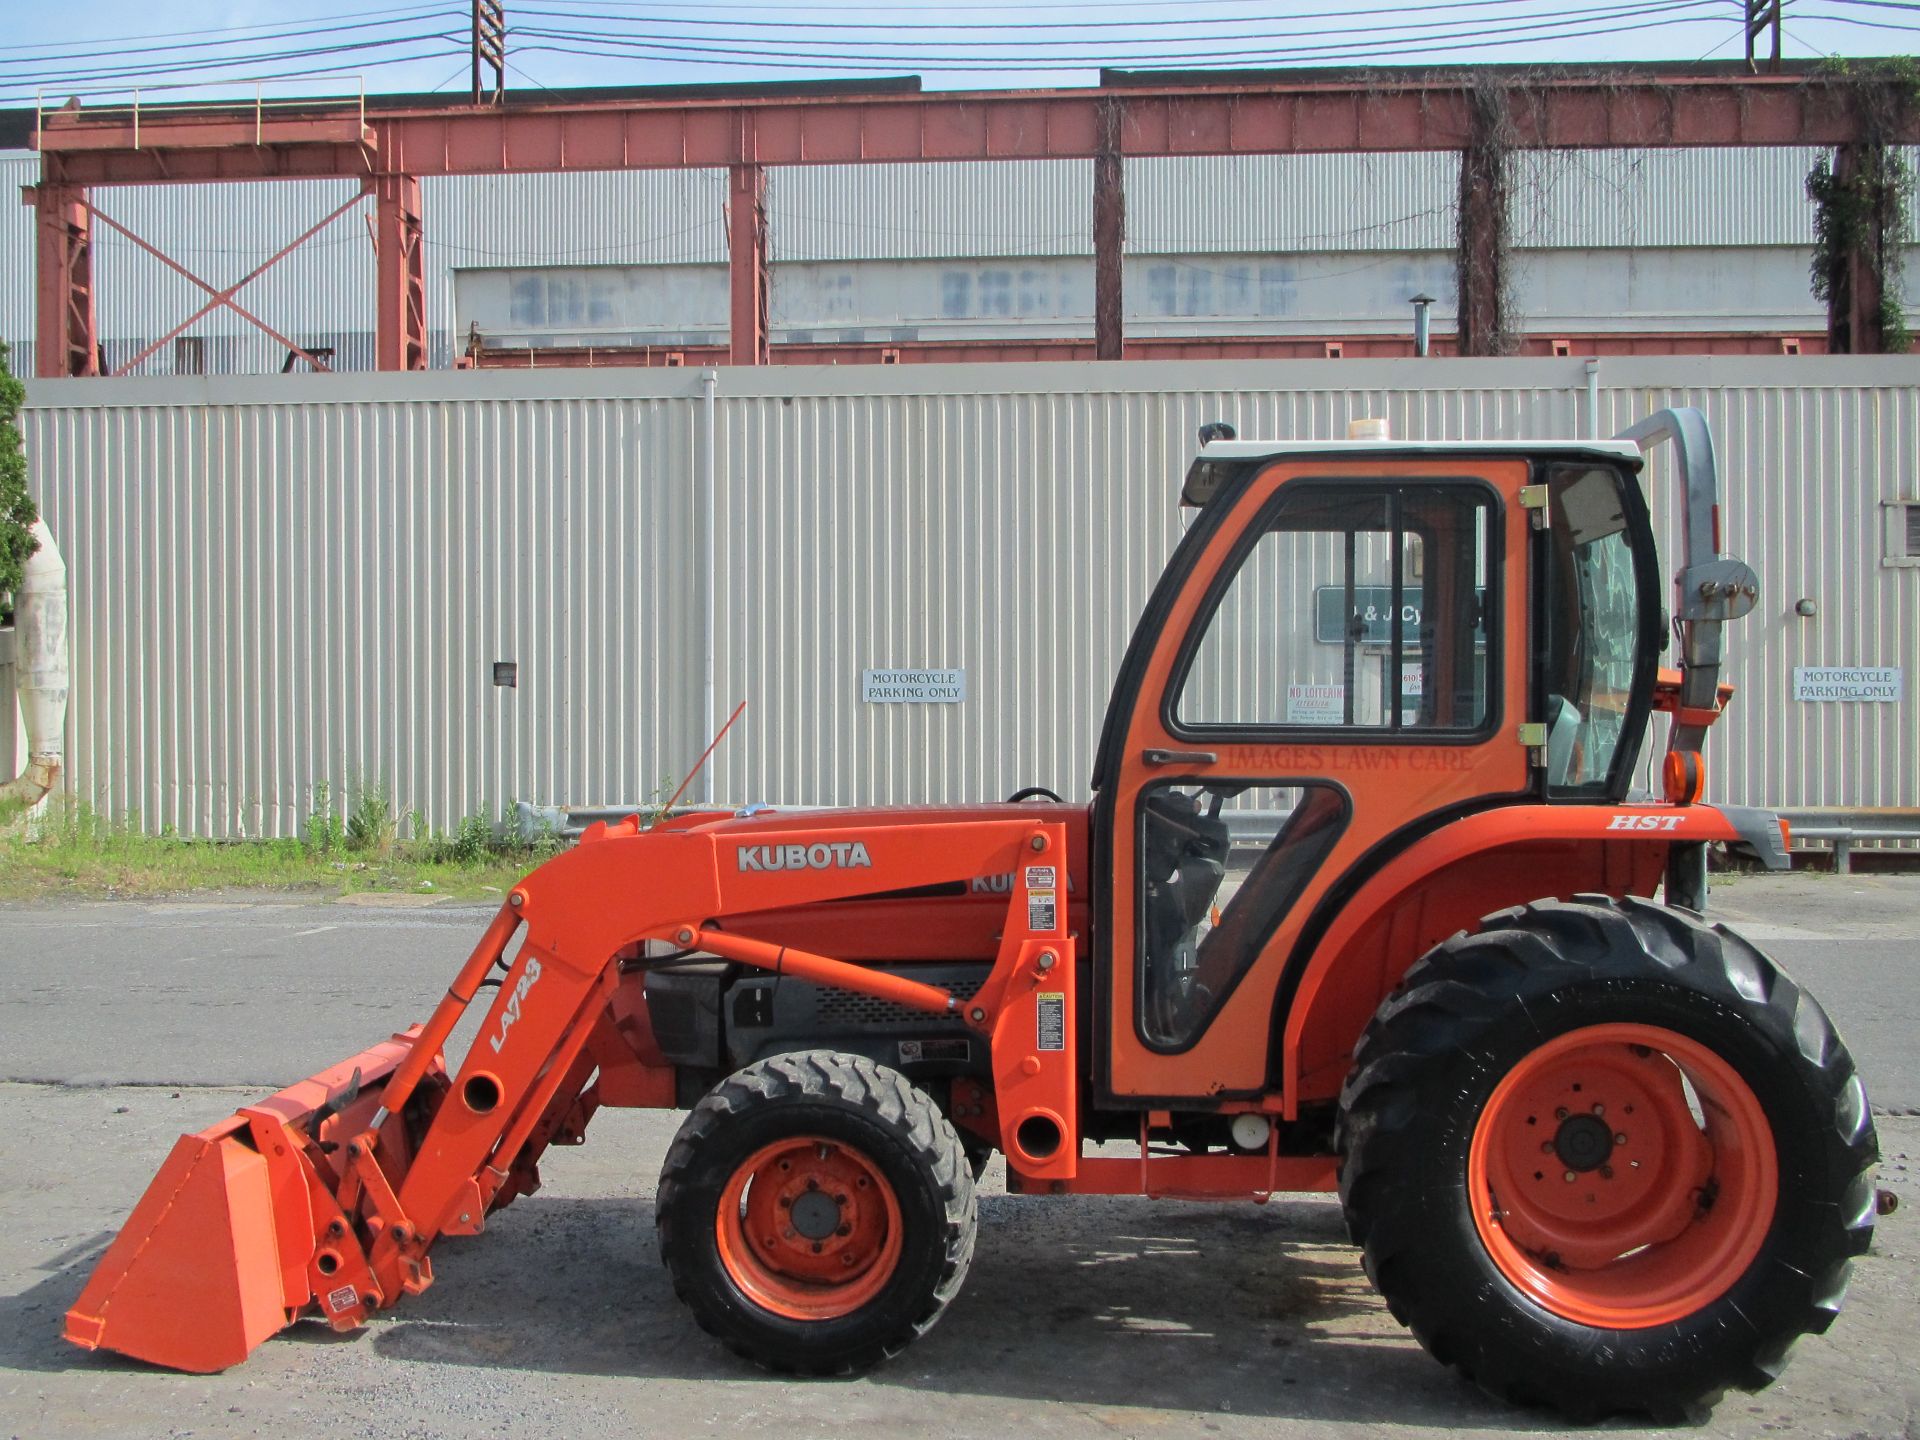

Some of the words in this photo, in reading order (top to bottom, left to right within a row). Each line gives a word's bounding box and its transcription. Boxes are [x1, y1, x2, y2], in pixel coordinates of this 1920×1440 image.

[1364, 605, 1378, 621] &
[872, 673, 956, 684] MOTORCYCLE
[1803, 671, 1892, 683] MOTORCYCLE
[868, 687, 924, 698] PARKING
[928, 687, 961, 698] ONLY
[1289, 687, 1301, 698] NO
[1304, 687, 1345, 699] LOITERIN
[1800, 686, 1858, 698] PARKING
[1863, 686, 1897, 697] ONLY
[1227, 746, 1325, 770] IMAGES
[1331, 746, 1400, 770] LAWN
[1407, 748, 1474, 771] CARE
[1606, 815, 1686, 831] HST
[738, 841, 872, 871] KUBOTA
[489, 957, 541, 1054] LA723
